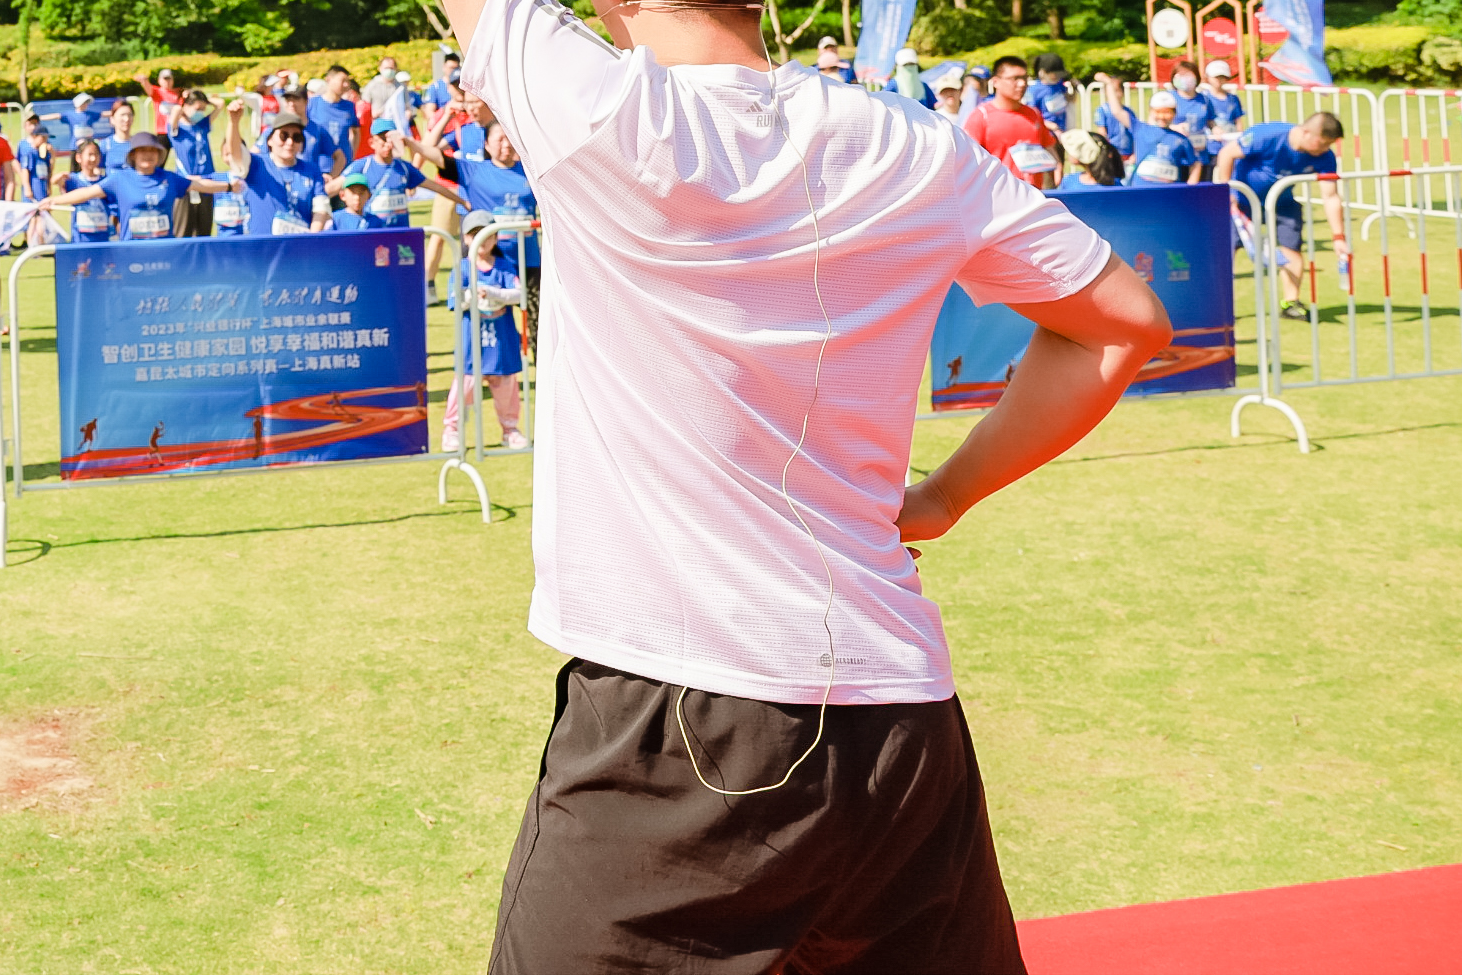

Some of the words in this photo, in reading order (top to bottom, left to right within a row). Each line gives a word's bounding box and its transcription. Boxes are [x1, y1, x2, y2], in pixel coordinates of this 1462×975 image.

[101, 336, 247, 364] 智创卫生健康家园
[250, 328, 390, 354] 悦享幸福和谐真新
